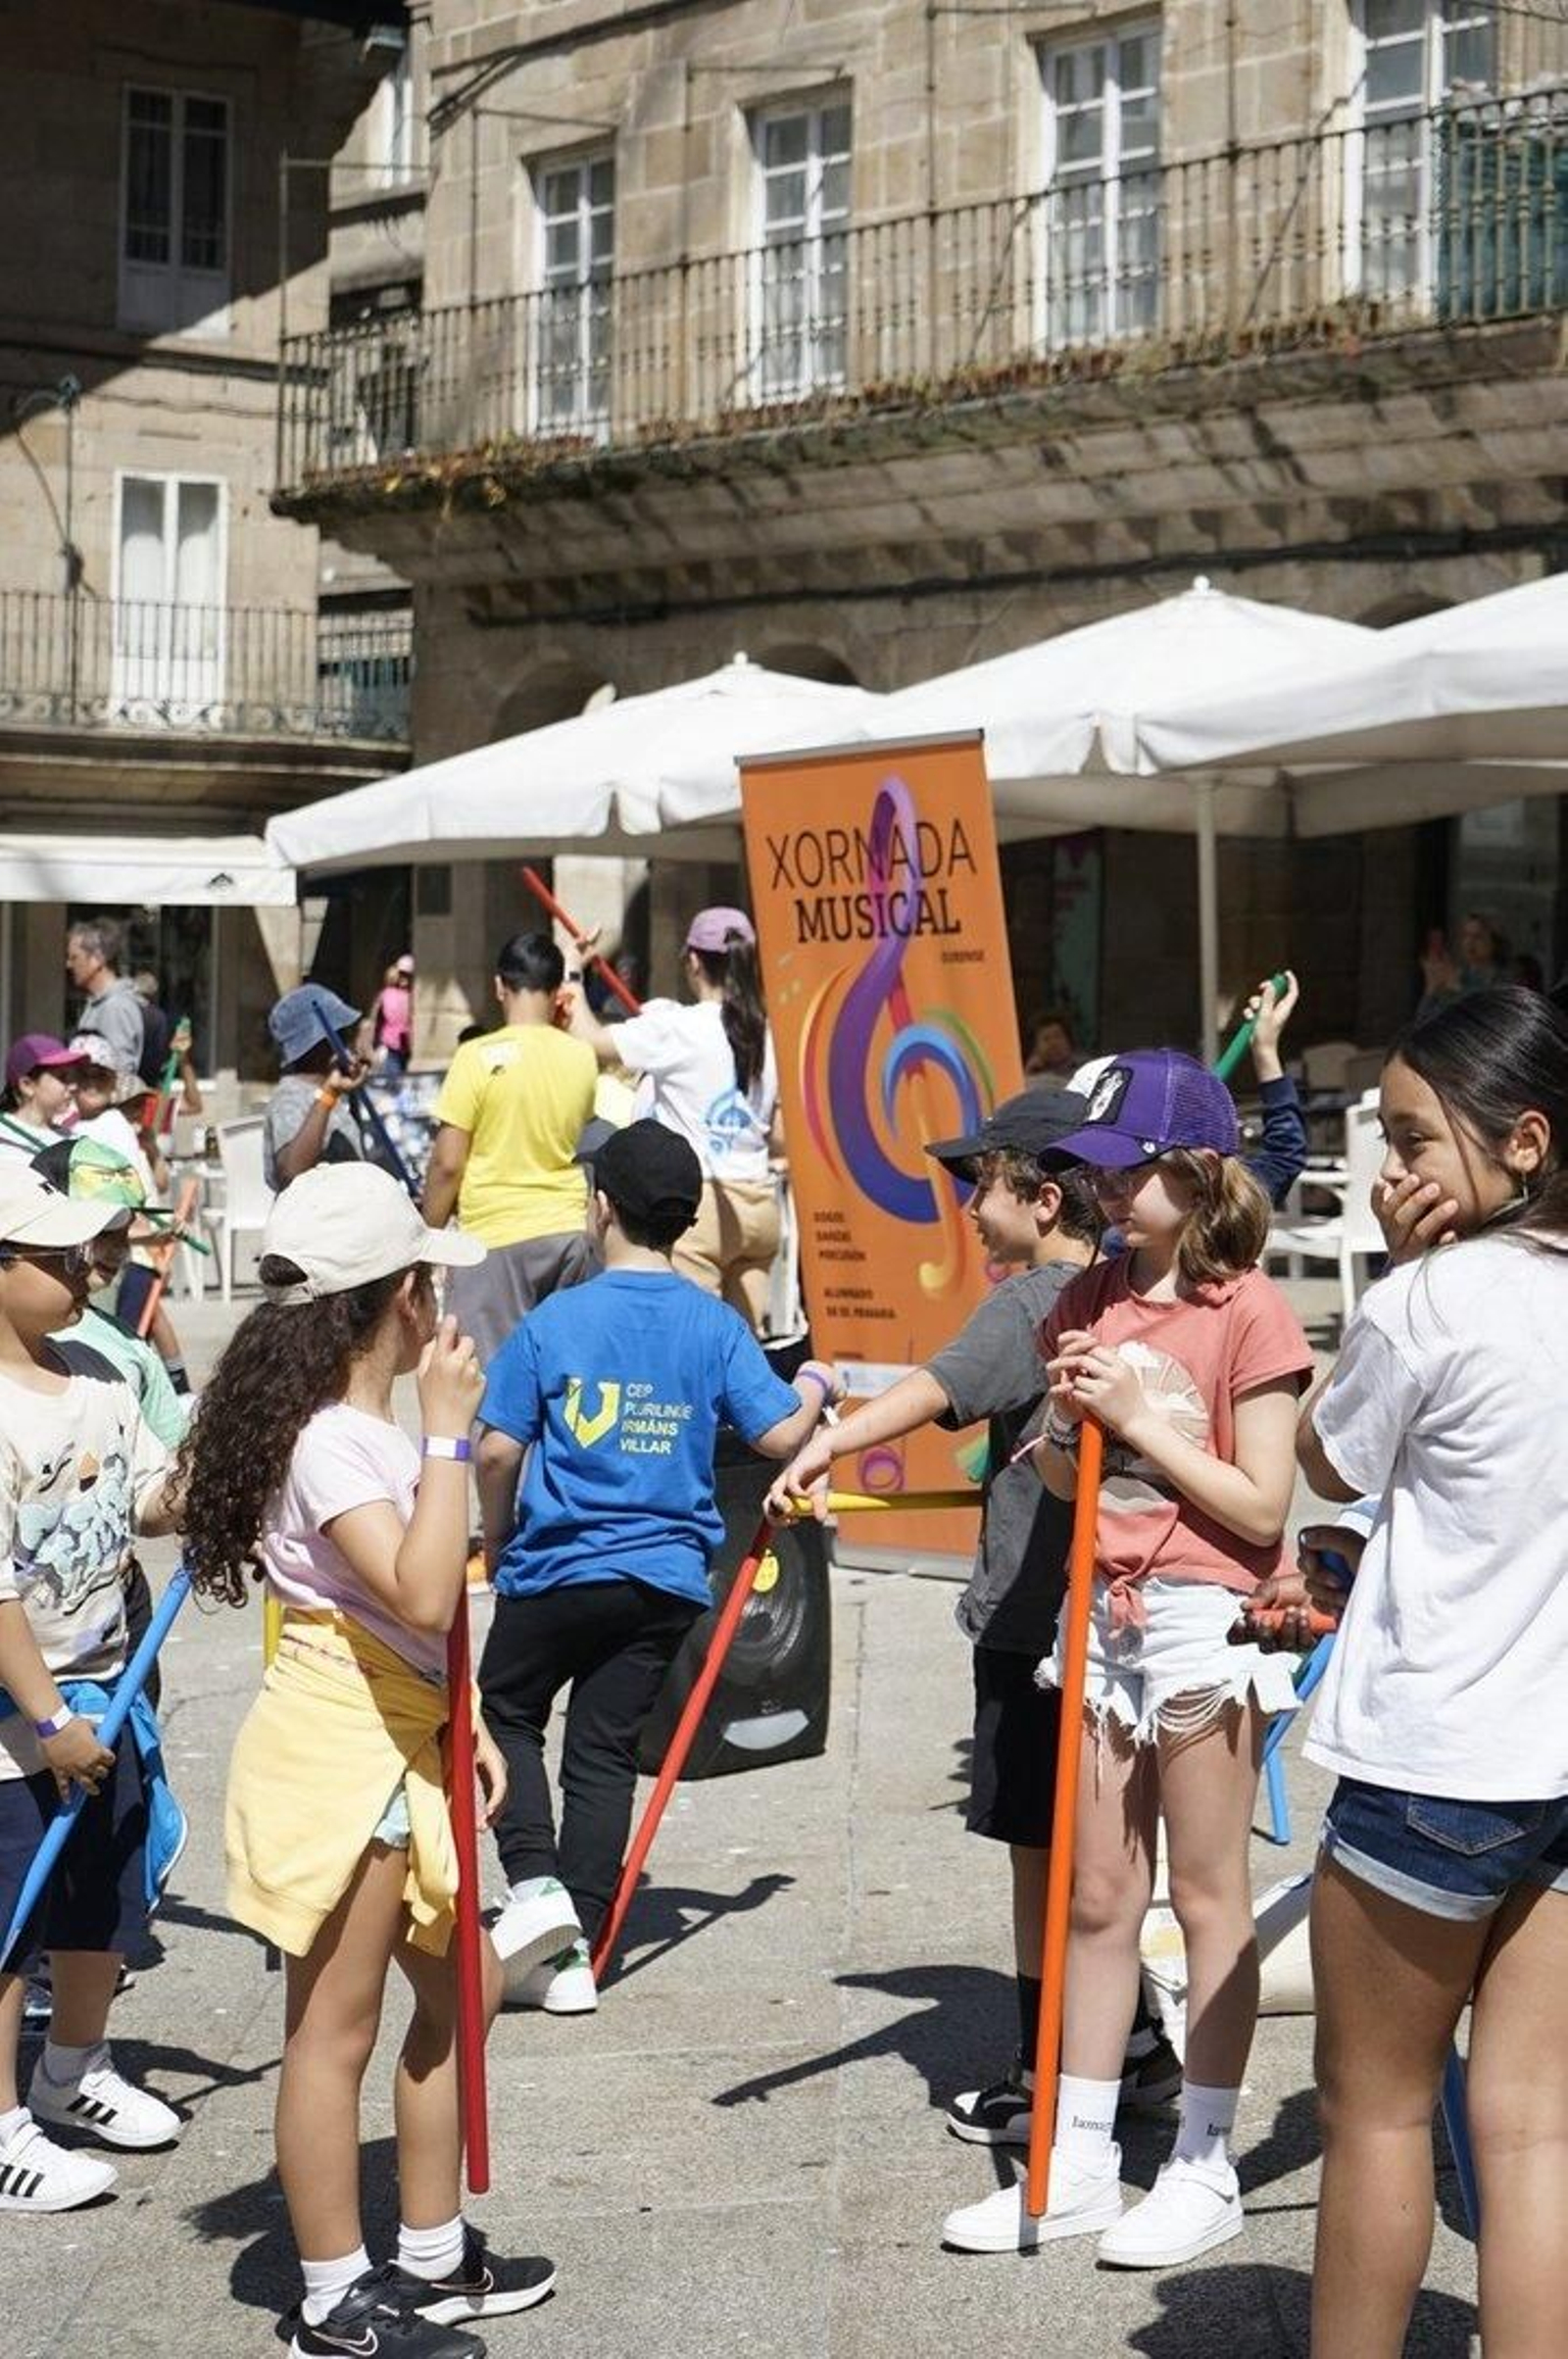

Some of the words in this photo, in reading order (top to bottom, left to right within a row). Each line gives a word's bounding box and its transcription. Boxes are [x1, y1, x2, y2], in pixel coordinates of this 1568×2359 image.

[766, 817, 977, 890] XORNADA
[795, 888, 961, 943] MUSICAL
[625, 1383, 654, 1399] CEP
[619, 1438, 672, 1455] VILLAR
